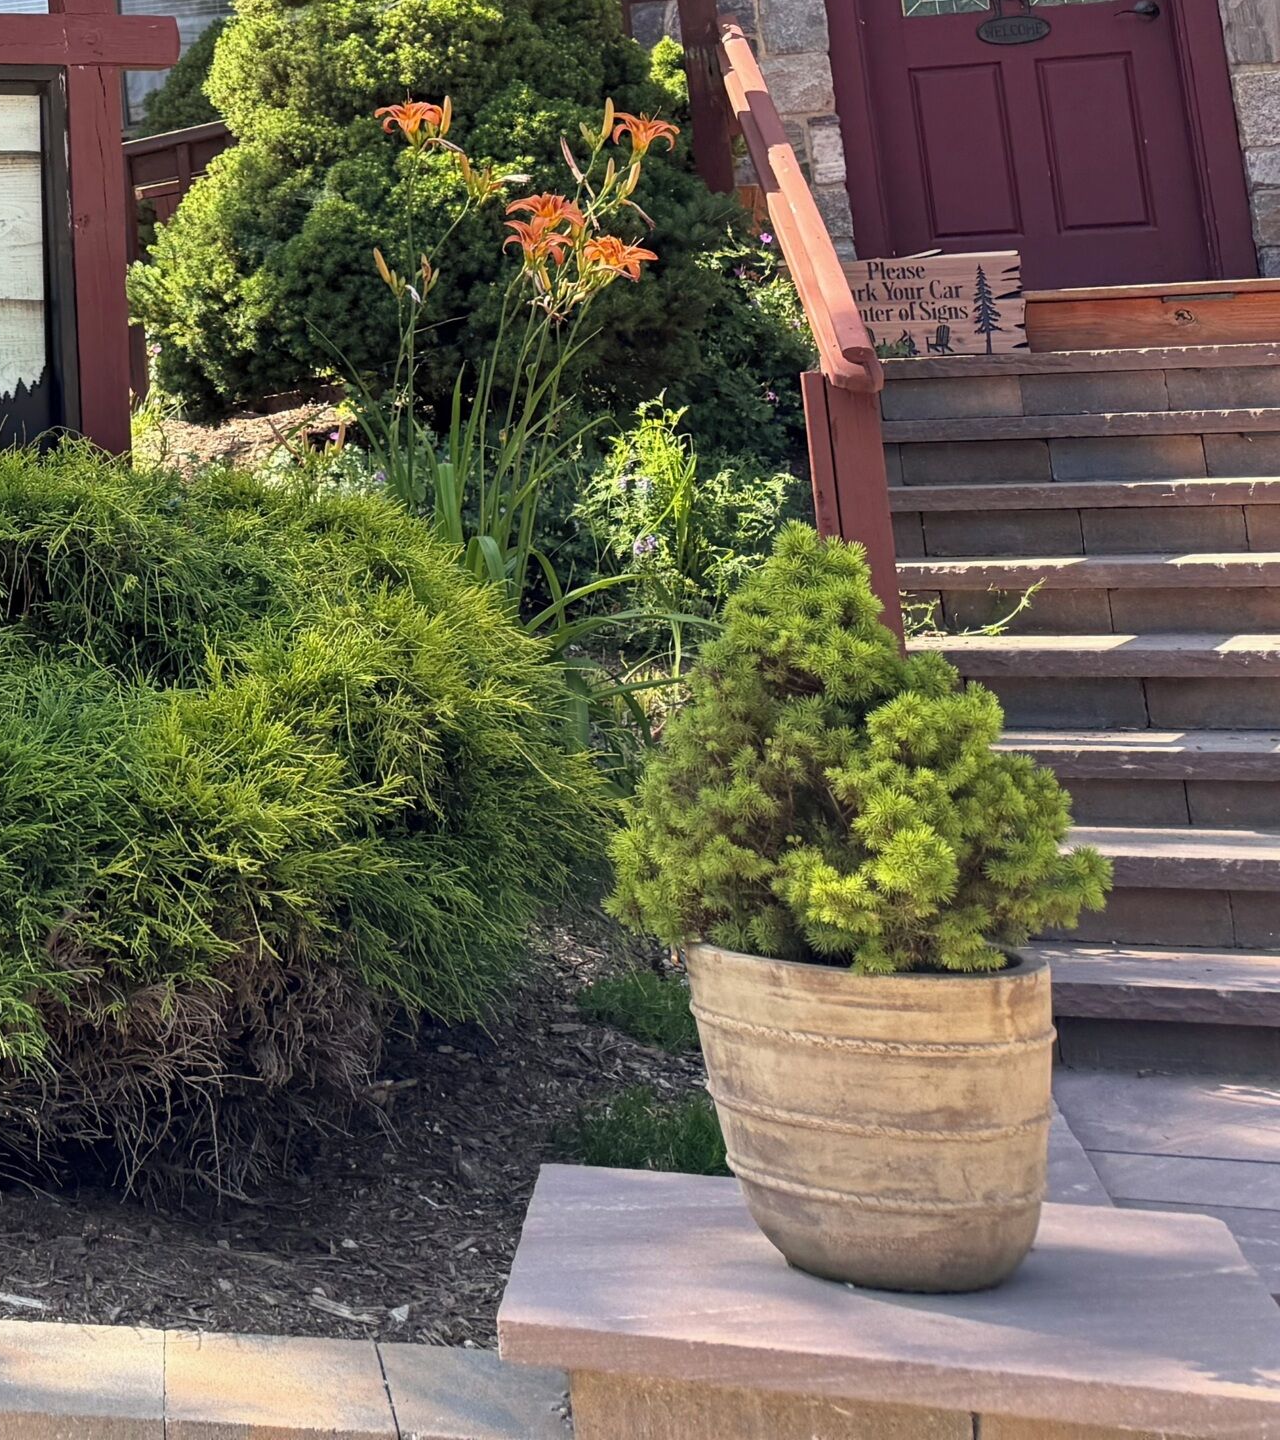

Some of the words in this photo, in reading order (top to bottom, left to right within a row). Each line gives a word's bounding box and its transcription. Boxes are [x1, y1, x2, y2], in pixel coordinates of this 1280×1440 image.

[984, 22, 1043, 38] WELCOME
[867, 261, 926, 281] Please
[881, 281, 924, 301] Your
[930, 279, 964, 299] Car
[858, 306, 894, 323] nter
[898, 301, 916, 322] of
[919, 301, 969, 324] Signs
